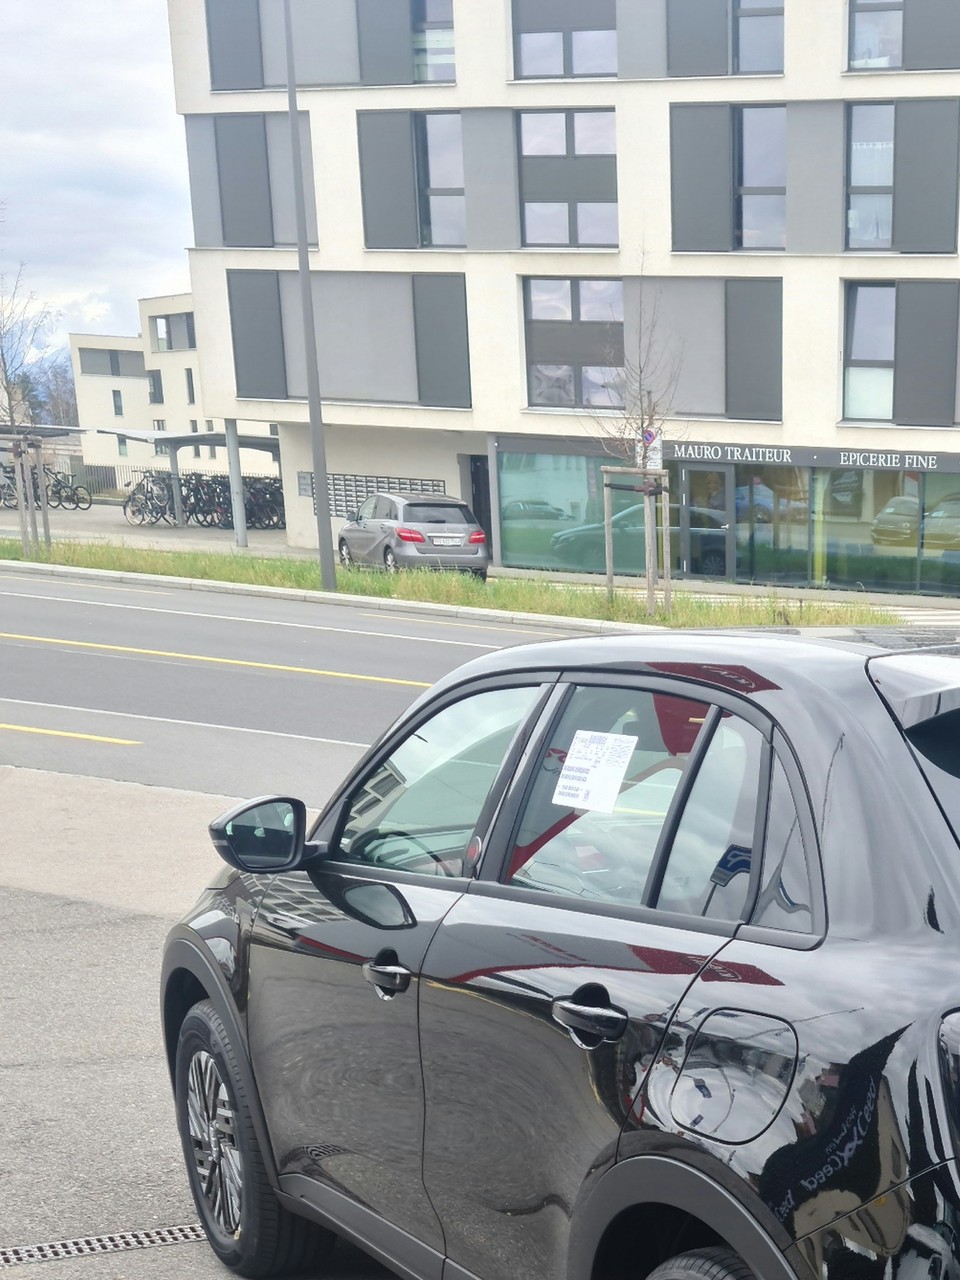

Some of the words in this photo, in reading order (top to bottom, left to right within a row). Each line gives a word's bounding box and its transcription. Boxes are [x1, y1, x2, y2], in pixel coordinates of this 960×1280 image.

[673, 444, 722, 460] MAURO
[725, 446, 792, 463] TRAITEUR
[839, 452, 900, 467] EPICERIE
[904, 455, 937, 469] FINE
